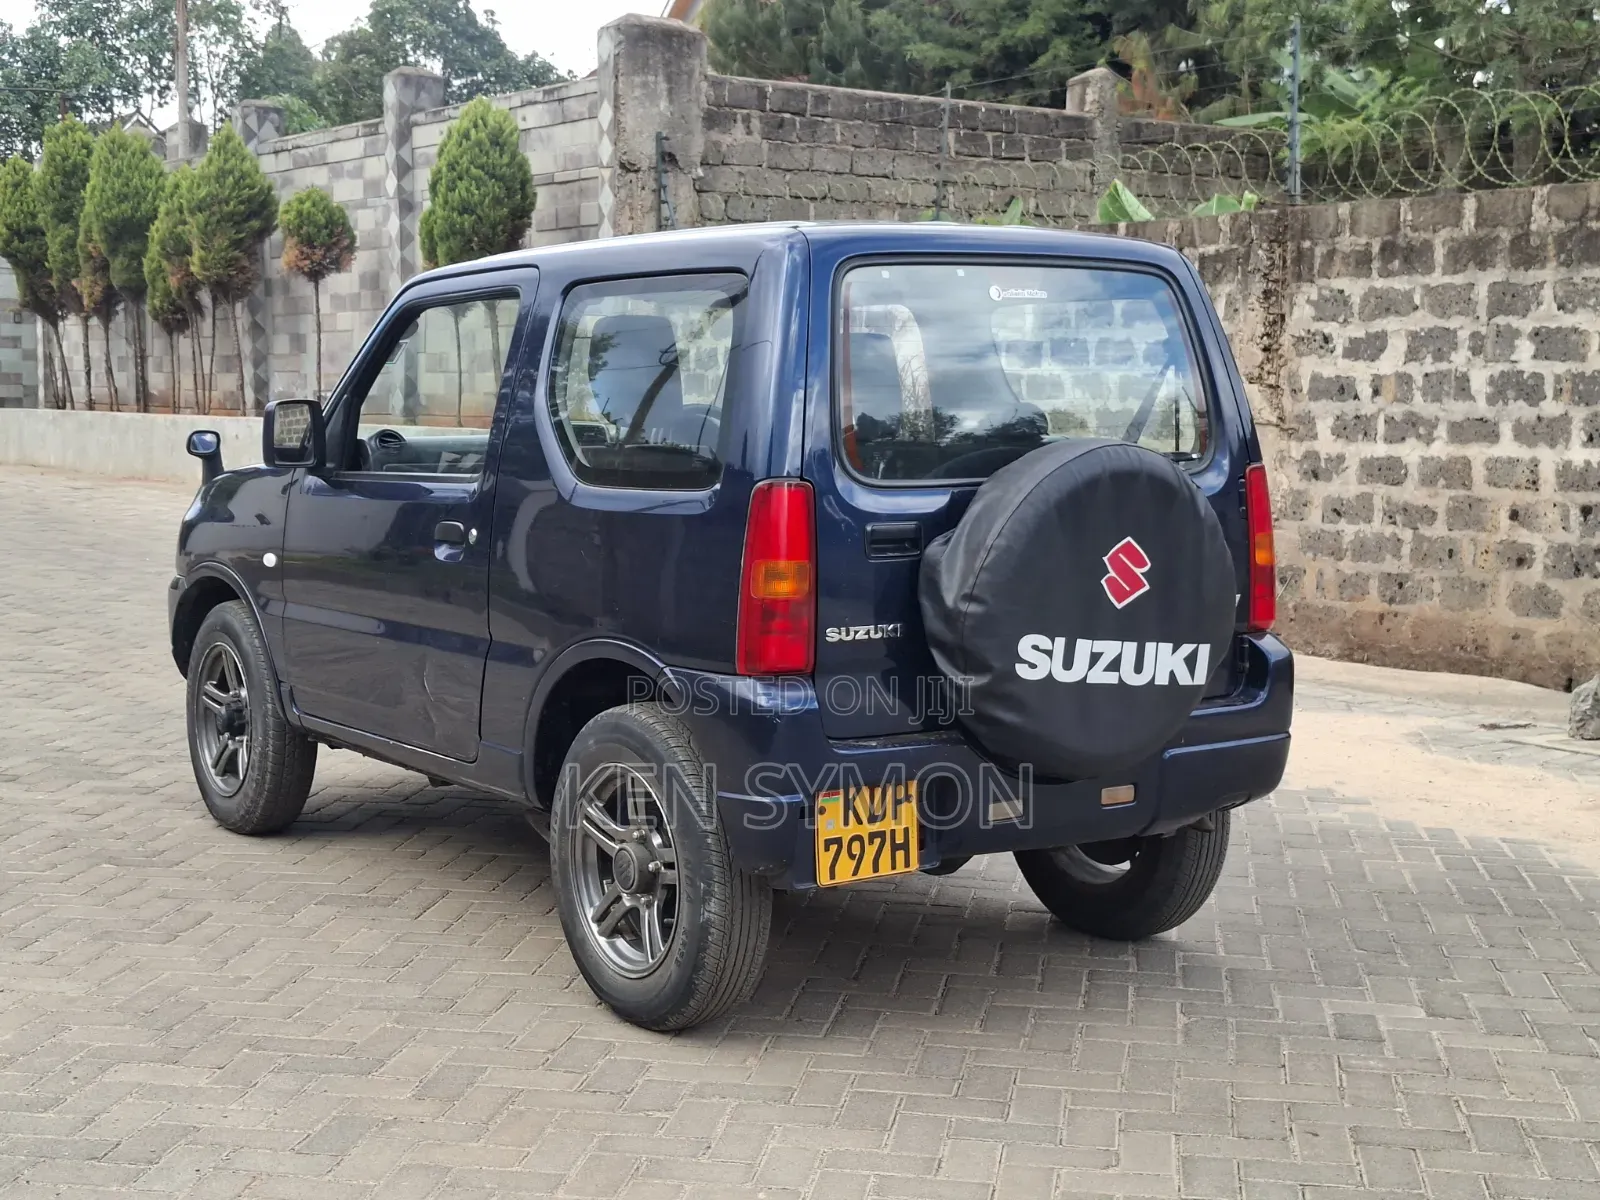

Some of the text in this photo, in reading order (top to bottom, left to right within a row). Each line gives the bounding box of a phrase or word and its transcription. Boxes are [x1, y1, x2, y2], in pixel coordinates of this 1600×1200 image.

[825, 623, 902, 642] SUZUKI
[1014, 634, 1210, 686] SUZUKI
[824, 827, 910, 880] 797H
